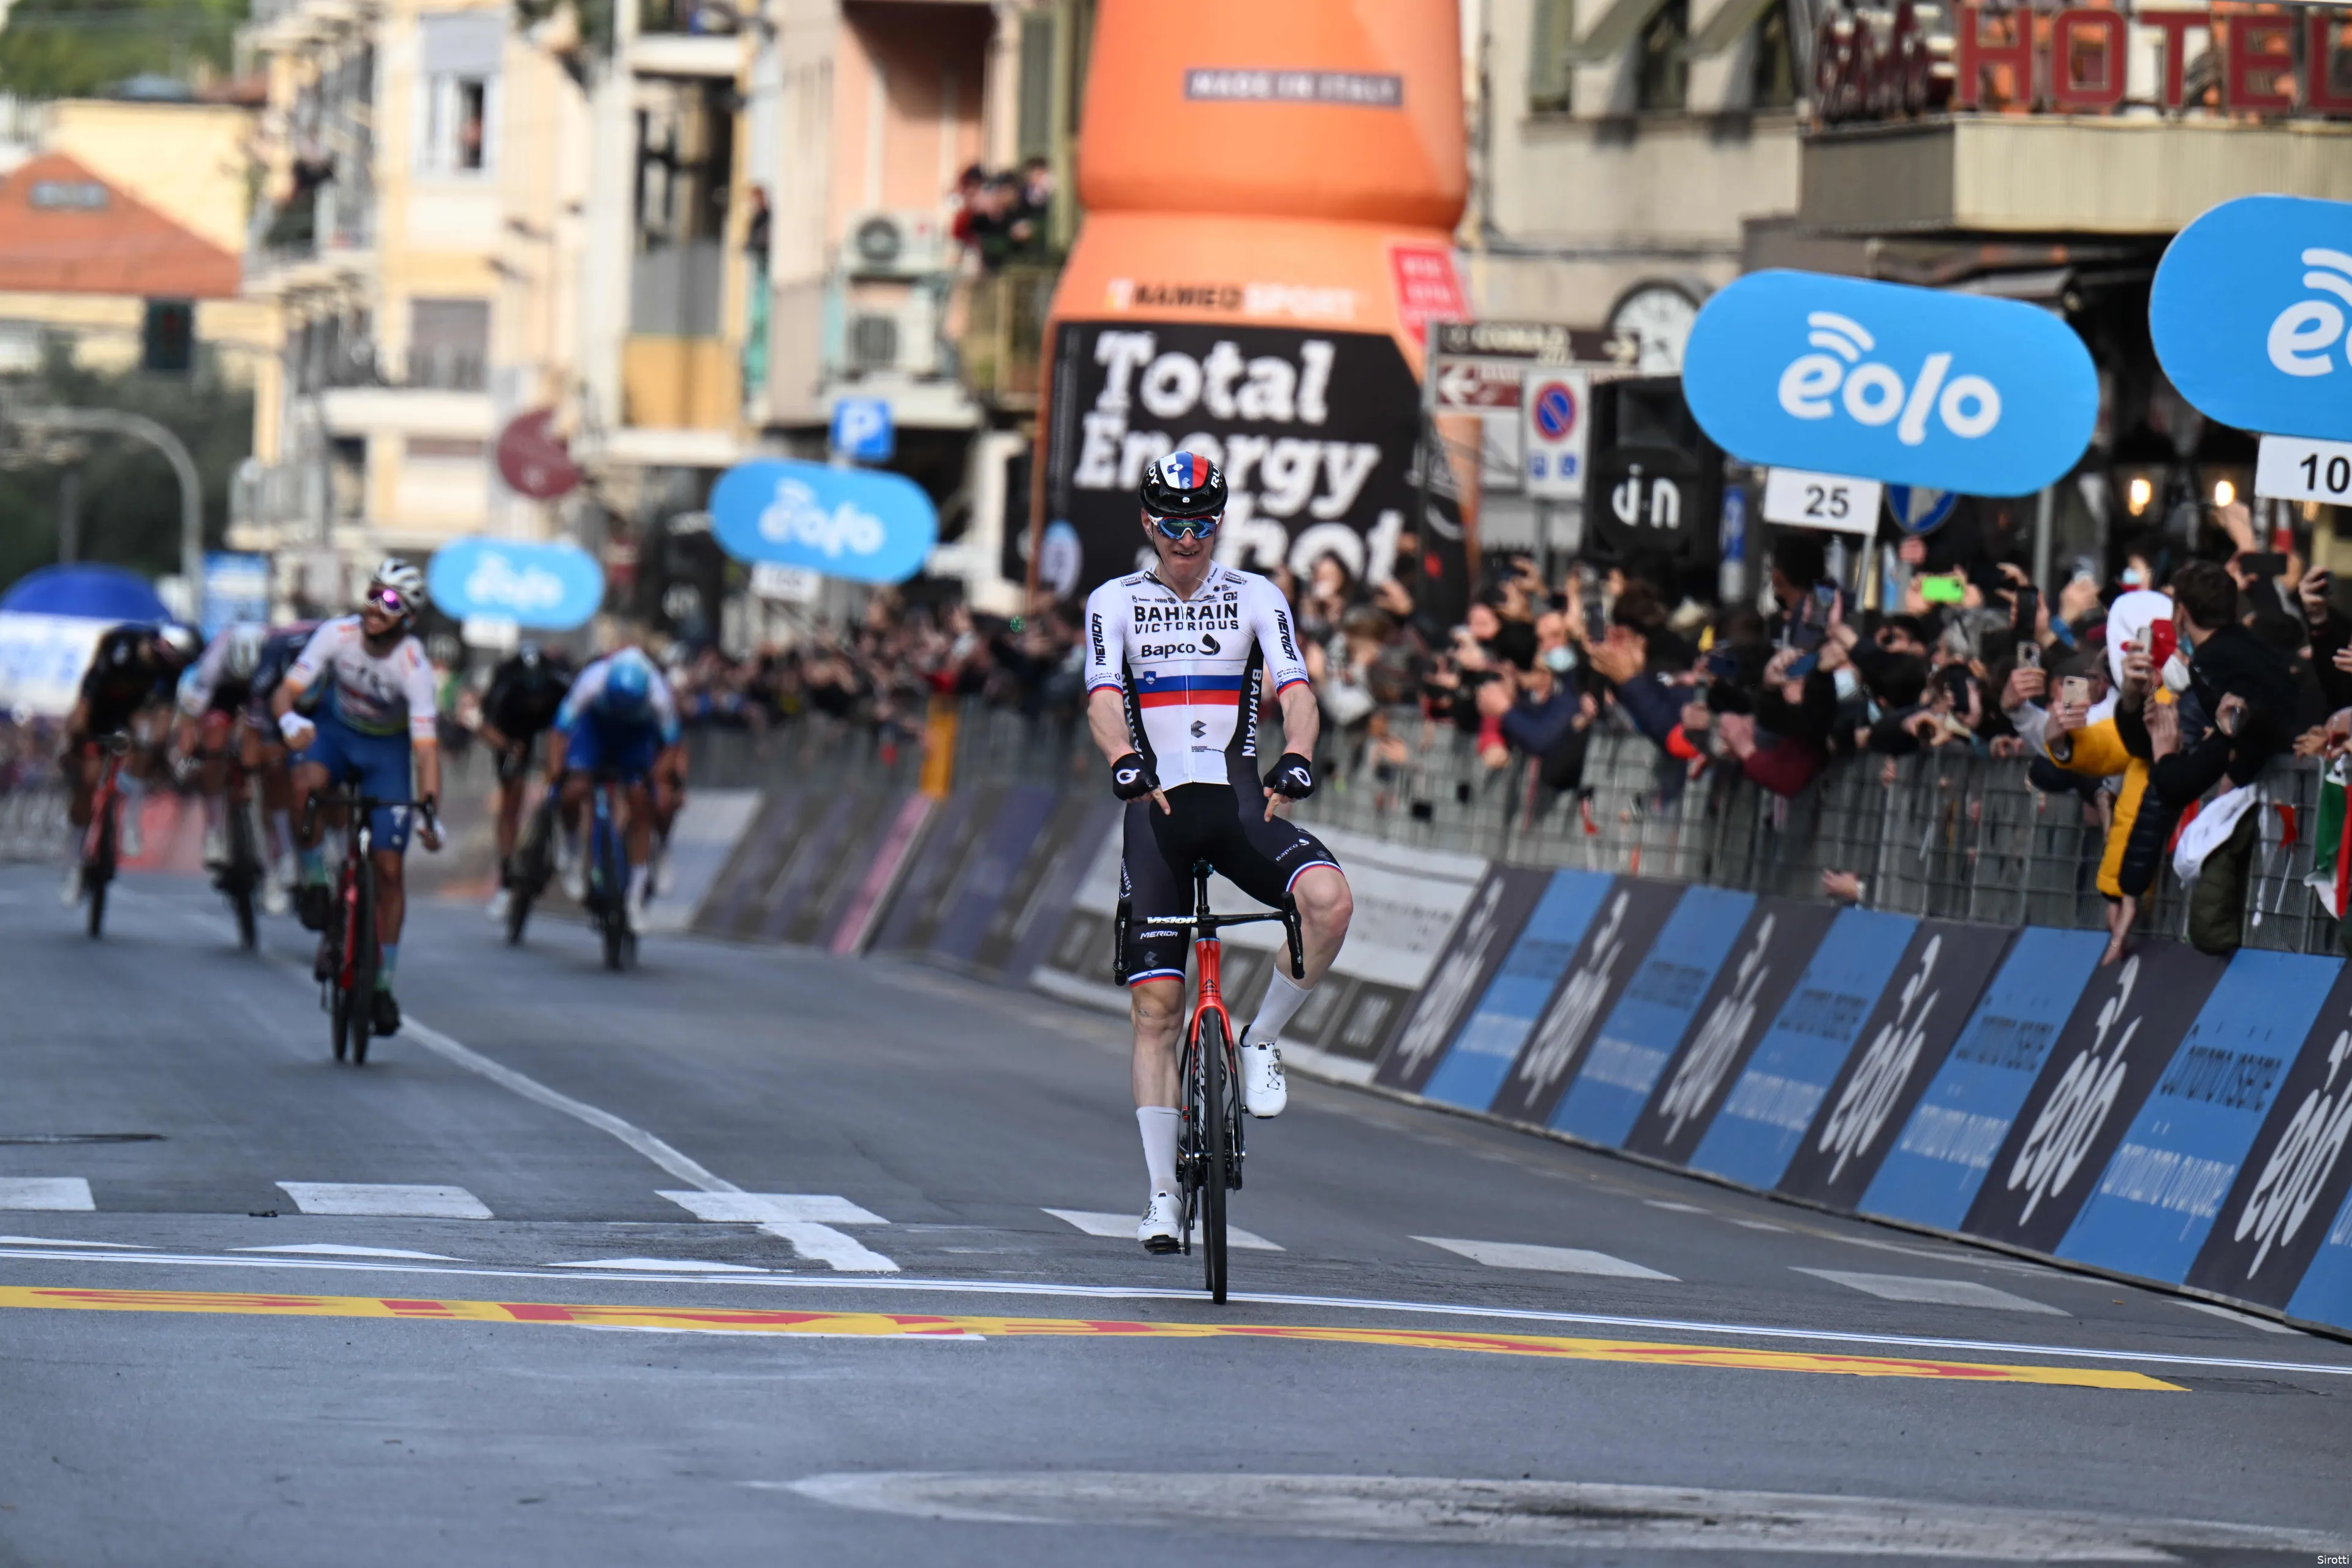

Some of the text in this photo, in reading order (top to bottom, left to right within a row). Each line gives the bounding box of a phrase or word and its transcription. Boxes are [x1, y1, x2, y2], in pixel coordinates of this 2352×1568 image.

[1960, 5, 2352, 113] HOTEL
[1191, 71, 1396, 105] MADE IN ITALY
[1093, 330, 1336, 424] Total
[1778, 353, 2001, 445] eolo
[2300, 453, 2351, 494] 10
[1804, 484, 1850, 518] 25
[1136, 495, 1405, 588] hot
[1134, 603, 1237, 622] BAHRAIN
[1135, 620, 1238, 634] VICTORIOUS
[1092, 613, 1106, 665] MERIDA
[1141, 643, 1196, 658] Bapco
[1275, 609, 1298, 662] MERIDA
[1242, 669, 1262, 757] BAHRAIN
[1275, 844, 1298, 861] Bapco
[1140, 930, 1178, 939] MERIDA
